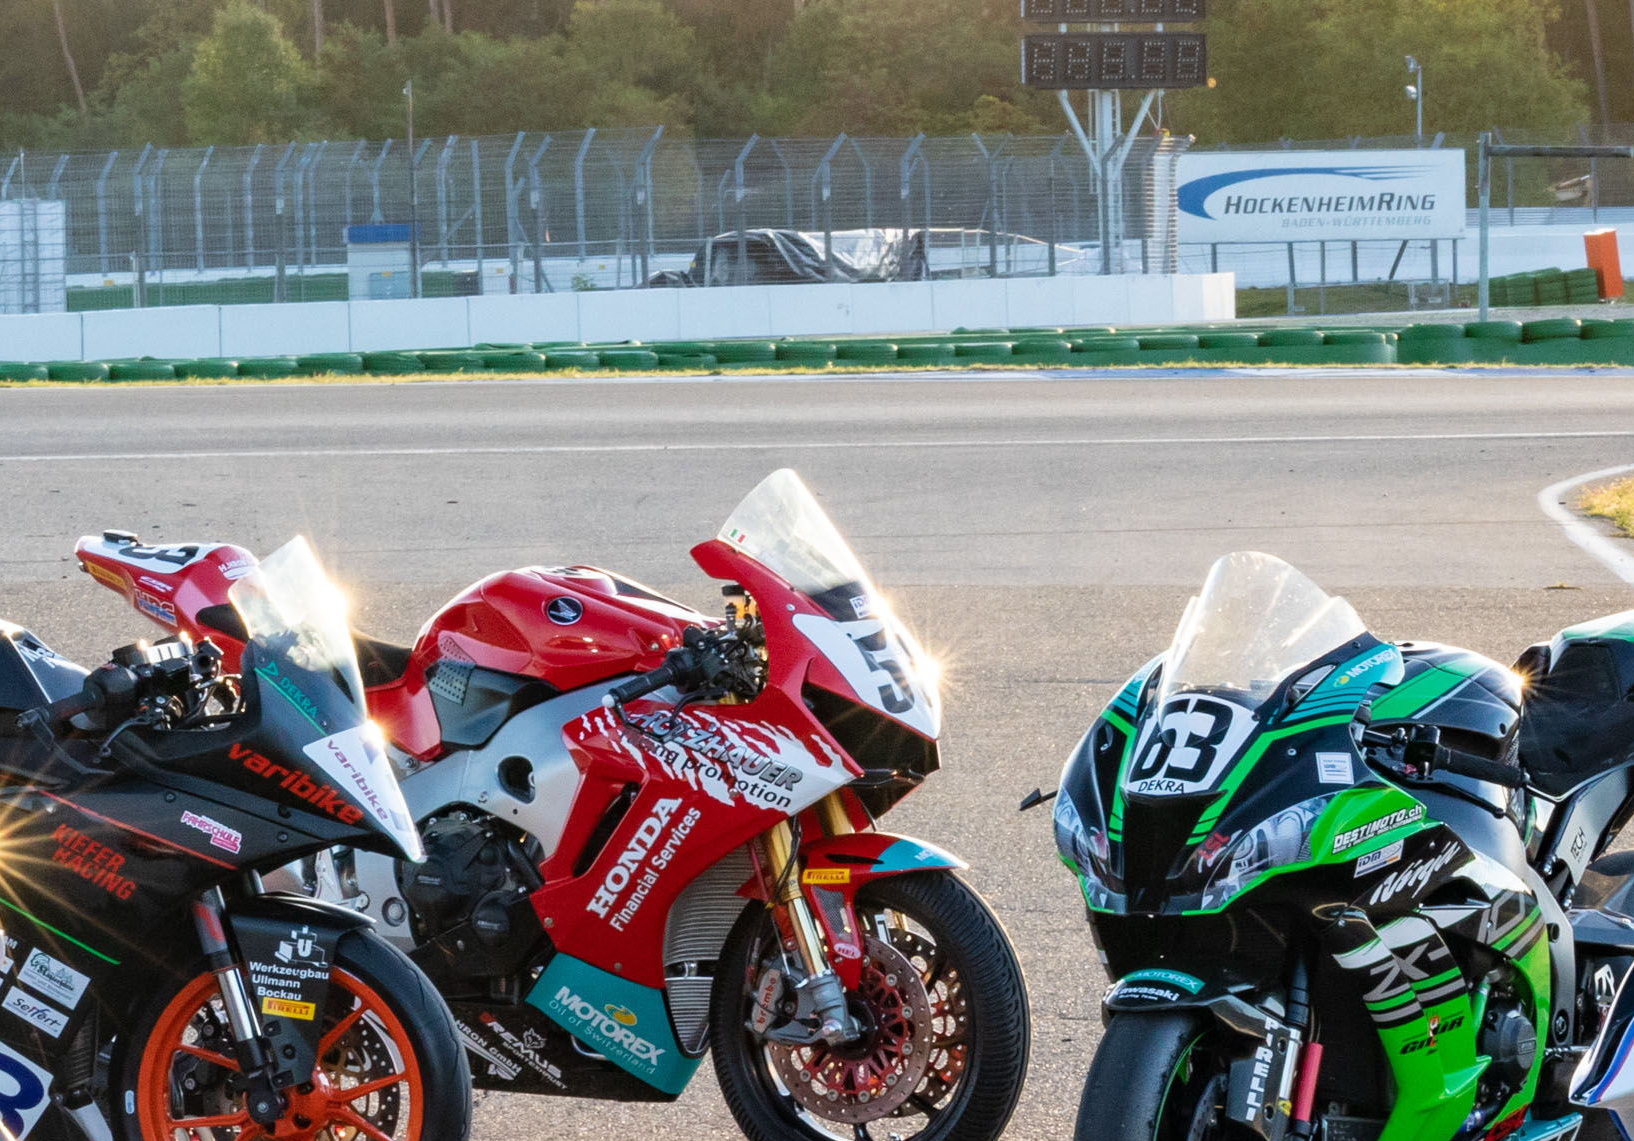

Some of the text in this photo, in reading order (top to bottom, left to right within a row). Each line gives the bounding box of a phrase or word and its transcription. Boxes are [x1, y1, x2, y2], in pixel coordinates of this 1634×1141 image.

[1346, 648, 1400, 679] MOTOREX
[279, 675, 318, 720] DEKRA
[1129, 698, 1234, 783] 63
[226, 742, 365, 826] varibike
[325, 739, 389, 821] varibike
[1137, 778, 1186, 795] DEKRA
[50, 823, 126, 873] KIEFER
[181, 811, 241, 846] FAHRSCHULE
[1332, 804, 1423, 850] DESTIMOTO.ch
[51, 846, 138, 901] RACING
[585, 797, 684, 920] HONDA
[609, 805, 702, 932] Financial Services
[805, 869, 848, 882] PIRELLI
[1369, 841, 1461, 906] Ninja
[249, 960, 330, 981] Werkzeugbau
[251, 974, 302, 990] Ullmann
[256, 986, 303, 1002] Bockau
[1136, 968, 1197, 990] MOTOREX
[266, 1000, 312, 1017] PIRELLI
[554, 985, 666, 1067] MOTOREX
[486, 1020, 563, 1080] REMUS
[488, 1046, 523, 1075] GmbH
[548, 999, 656, 1076] Oil of Switzerland
[1245, 1016, 1279, 1122] PIRELLI
